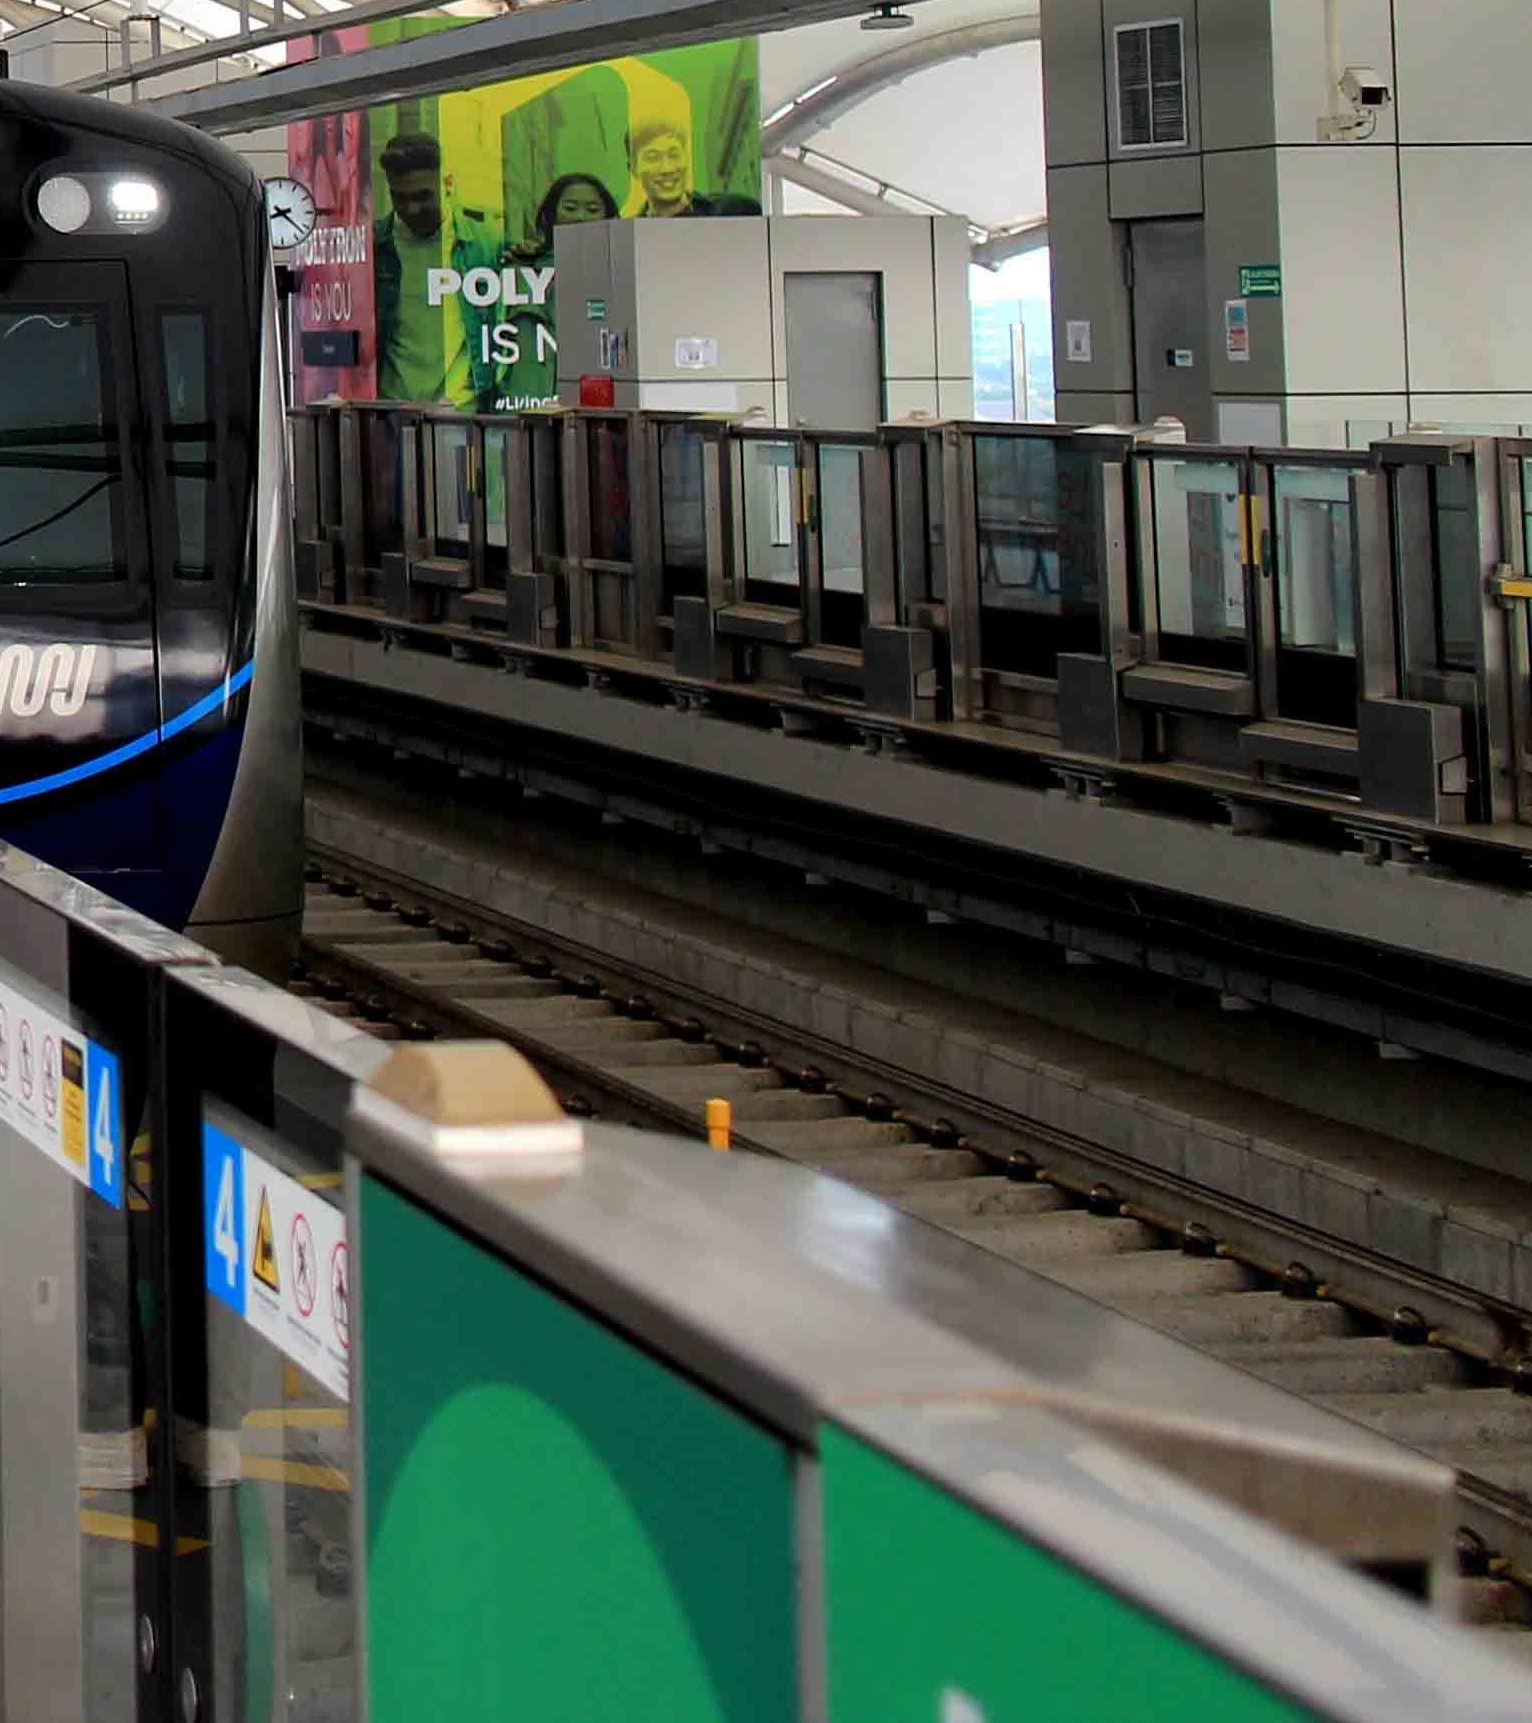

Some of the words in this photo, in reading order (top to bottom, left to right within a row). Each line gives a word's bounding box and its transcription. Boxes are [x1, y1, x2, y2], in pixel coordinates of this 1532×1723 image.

[310, 283, 323, 321] IS
[326, 282, 353, 322] YOU
[481, 322, 520, 365] IS
[95, 1065, 115, 1187] 4
[214, 1154, 239, 1287] 4
